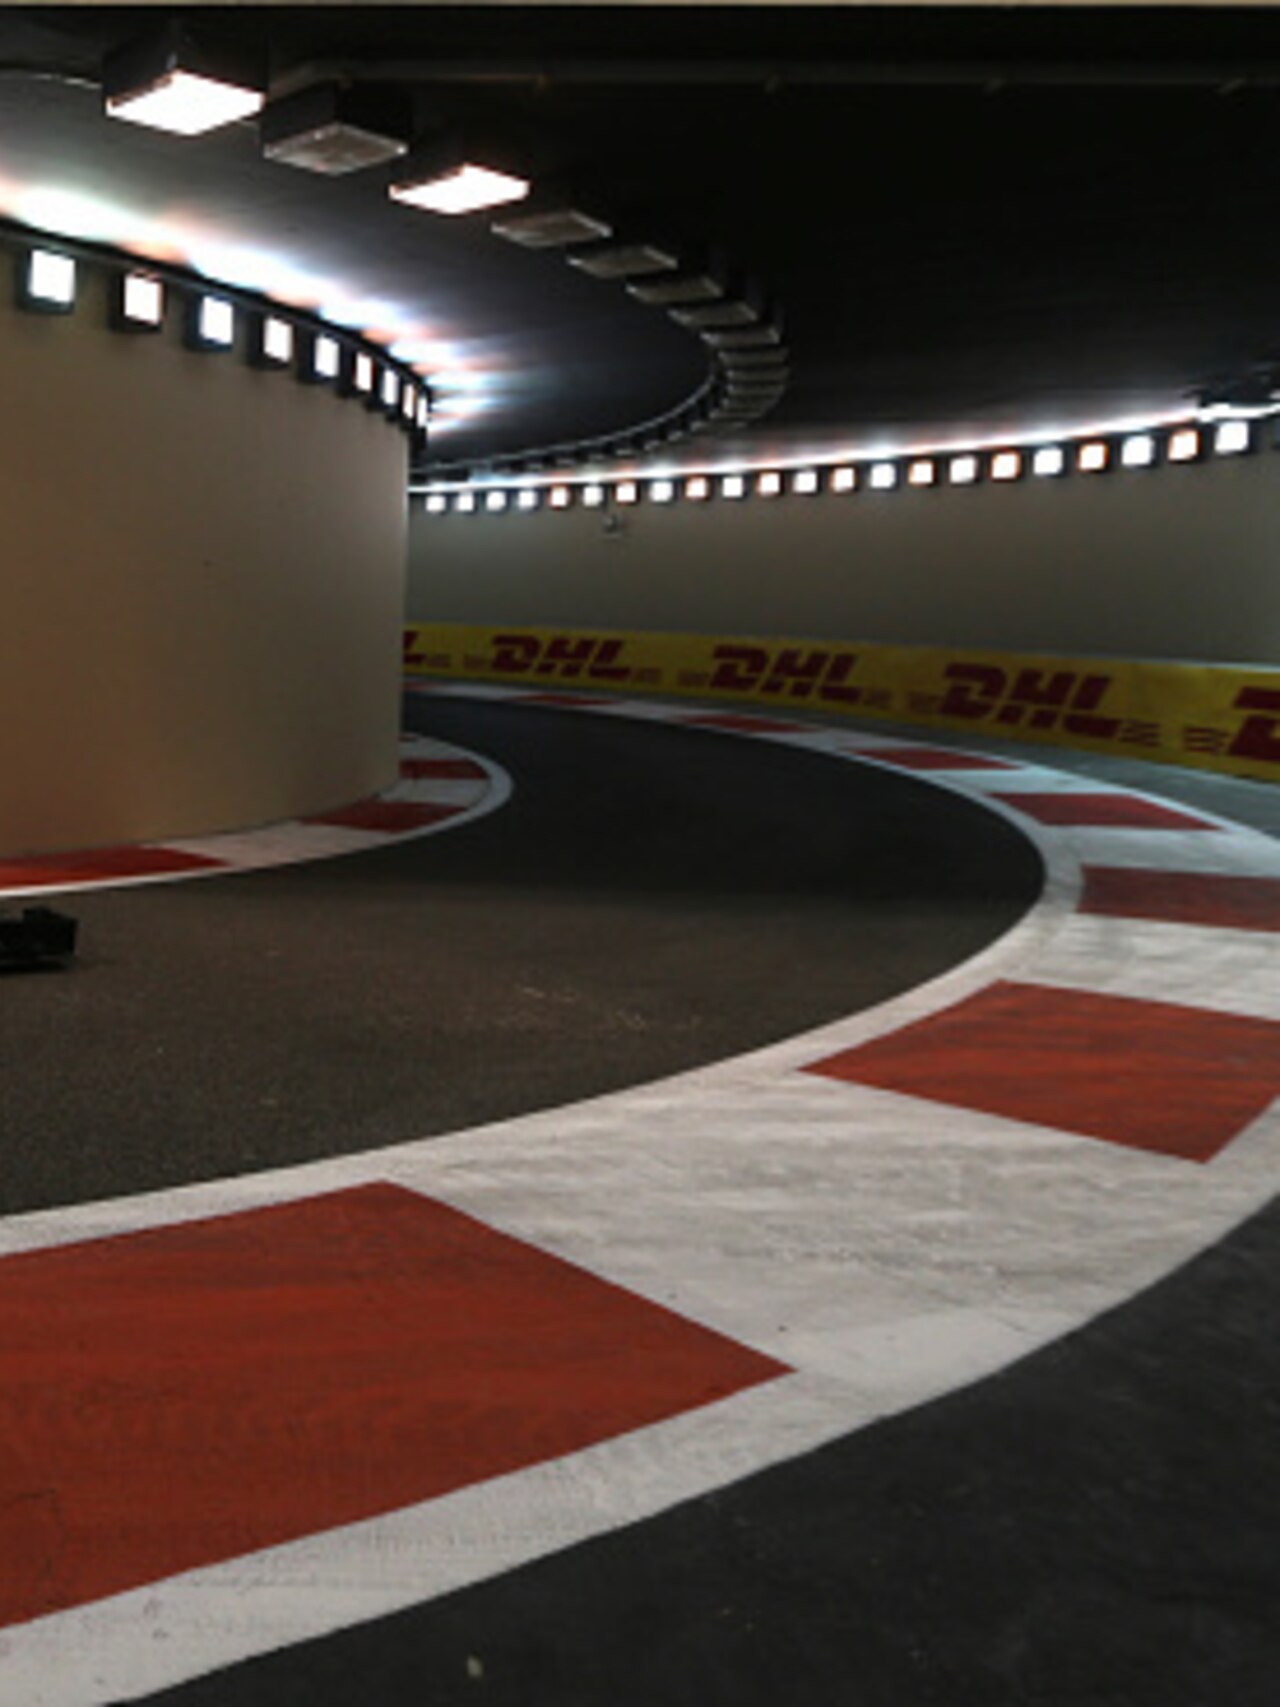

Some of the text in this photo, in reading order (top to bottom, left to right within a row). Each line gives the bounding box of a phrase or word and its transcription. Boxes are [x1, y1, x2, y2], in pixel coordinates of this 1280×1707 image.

[490, 634, 632, 682] DHL
[708, 644, 862, 704] DHL
[939, 662, 1123, 740] DHL
